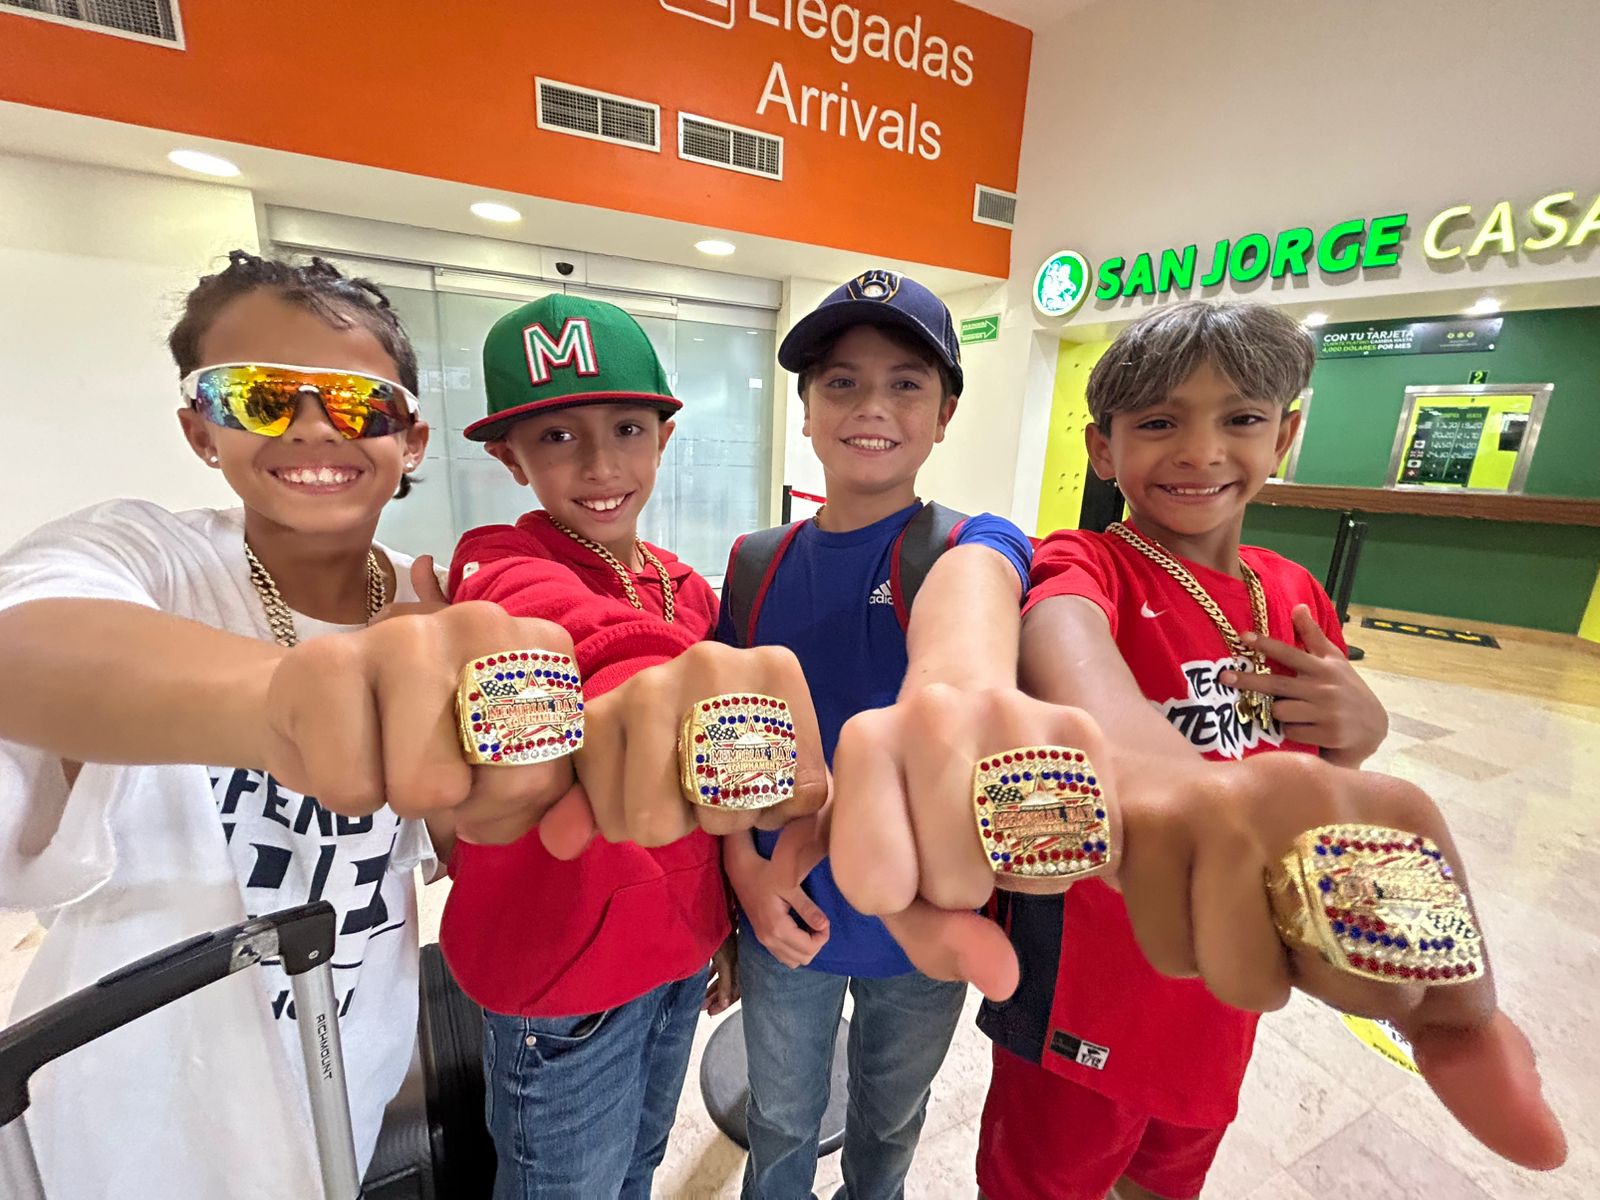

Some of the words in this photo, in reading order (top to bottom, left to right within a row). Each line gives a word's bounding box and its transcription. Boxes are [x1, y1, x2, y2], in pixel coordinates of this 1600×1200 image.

[756, 62, 942, 160] Arrivals
[1095, 244, 1197, 301] SAN
[1200, 213, 1408, 288] JORGE
[522, 316, 600, 387] M
[1323, 333, 1348, 343] CON
[1350, 332, 1365, 341] TU
[1366, 329, 1415, 340] TARJETA
[1473, 370, 1483, 385] 2
[554, 698, 577, 713] DAY
[770, 746, 791, 761] DAY
[315, 1013, 333, 1080] RICHMOUNT
